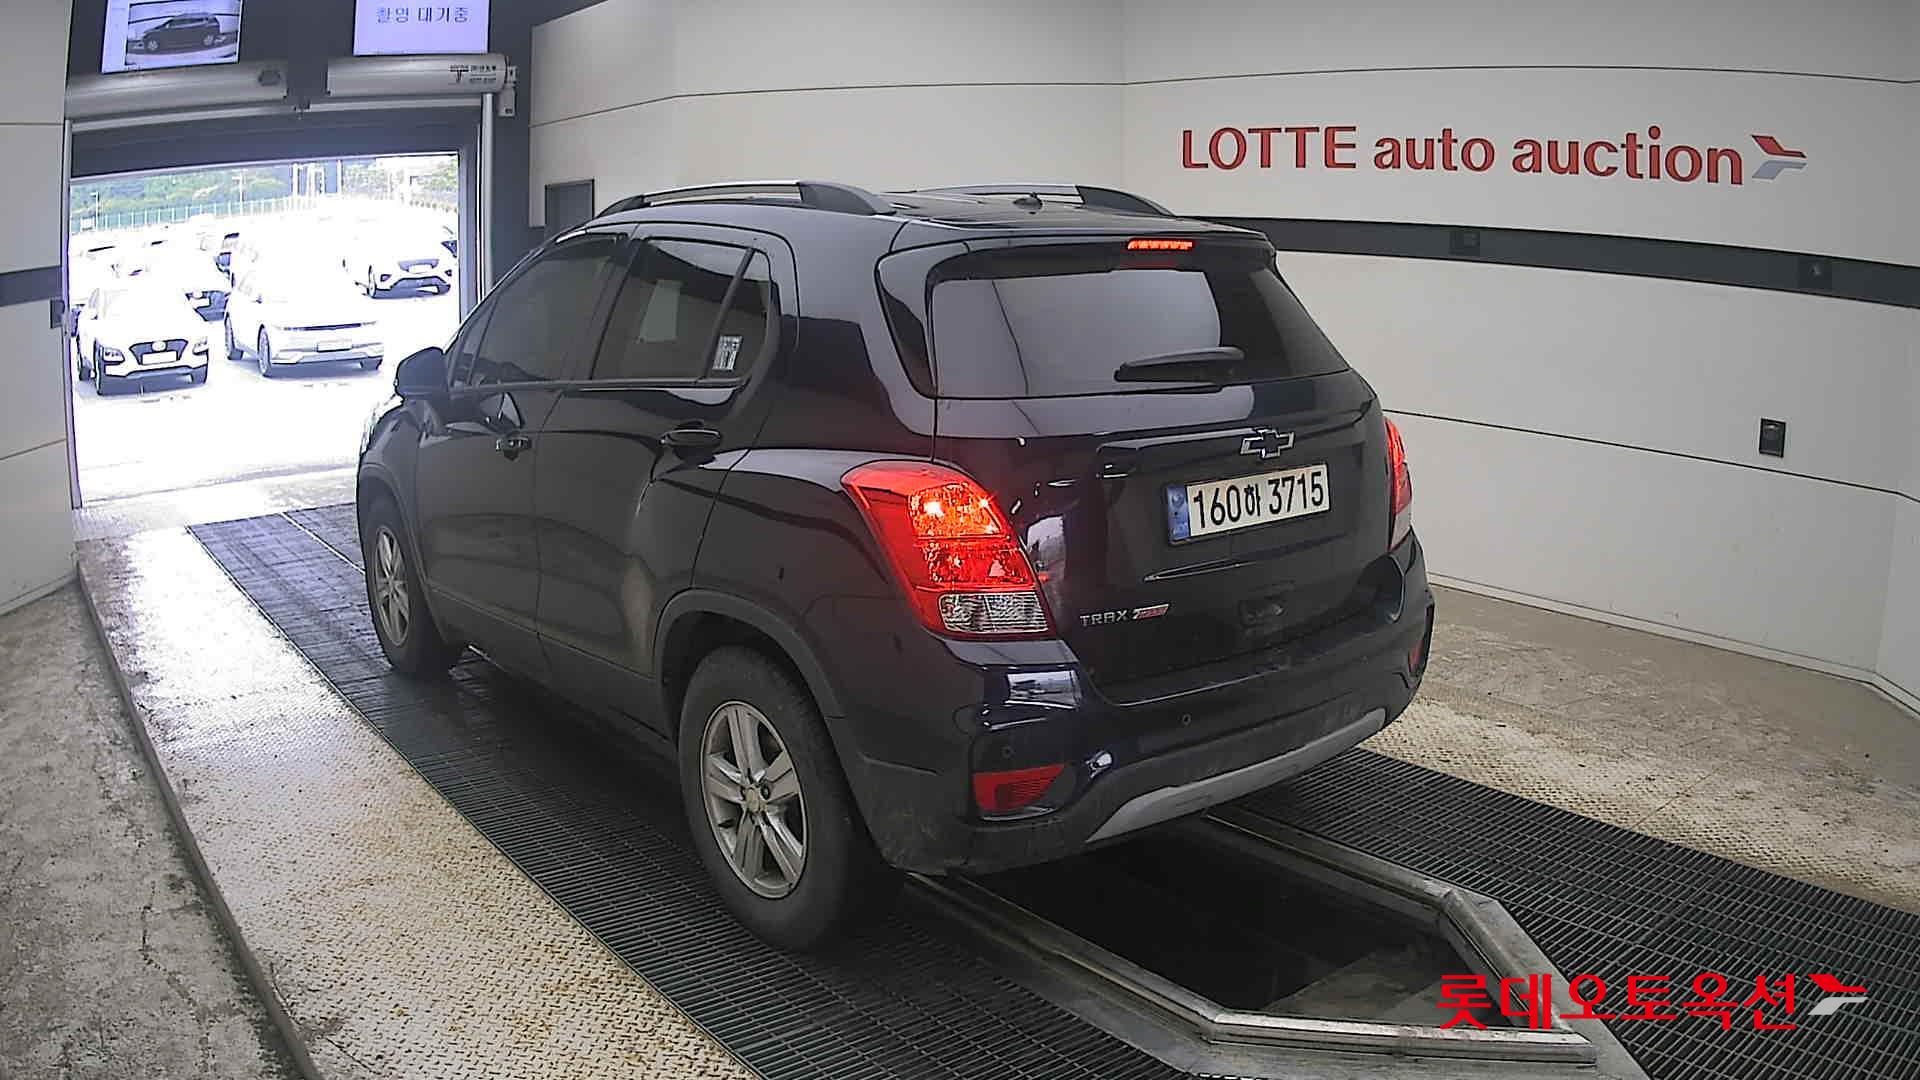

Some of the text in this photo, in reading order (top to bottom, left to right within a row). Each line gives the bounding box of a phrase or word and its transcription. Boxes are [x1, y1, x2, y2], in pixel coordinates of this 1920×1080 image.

[417, 7, 469, 23] 대기중
[1182, 126, 1743, 185] LOTTE auto auction
[1193, 471, 1324, 528] 160하 3715
[1080, 610, 1127, 627] TRAX
